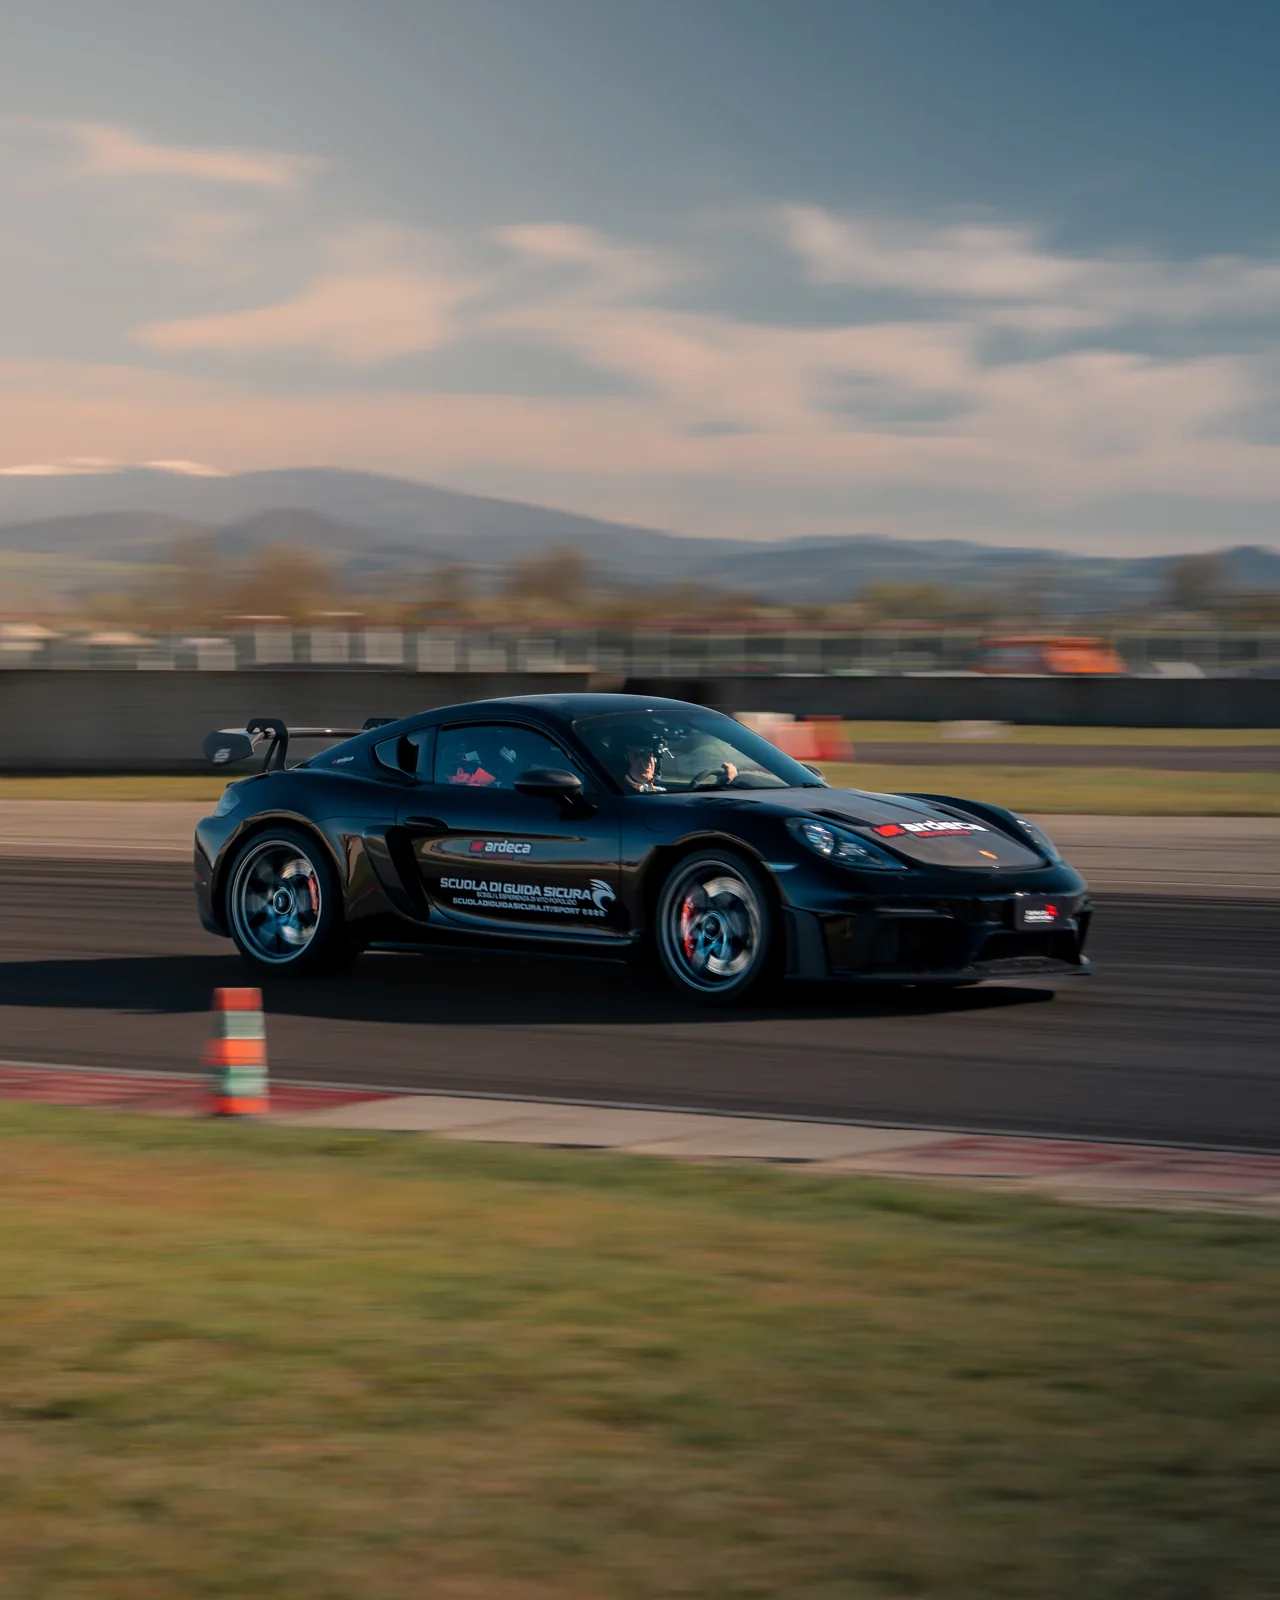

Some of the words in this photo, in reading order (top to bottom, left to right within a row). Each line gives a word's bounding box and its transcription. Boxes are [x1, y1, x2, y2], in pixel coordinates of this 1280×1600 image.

[899, 820, 989, 832] ardeca
[484, 840, 531, 854] ardeca
[440, 877, 488, 892] SCUOLA
[489, 881, 502, 893] DI
[503, 883, 542, 897] GUIDA
[543, 886, 592, 901] SICURA
